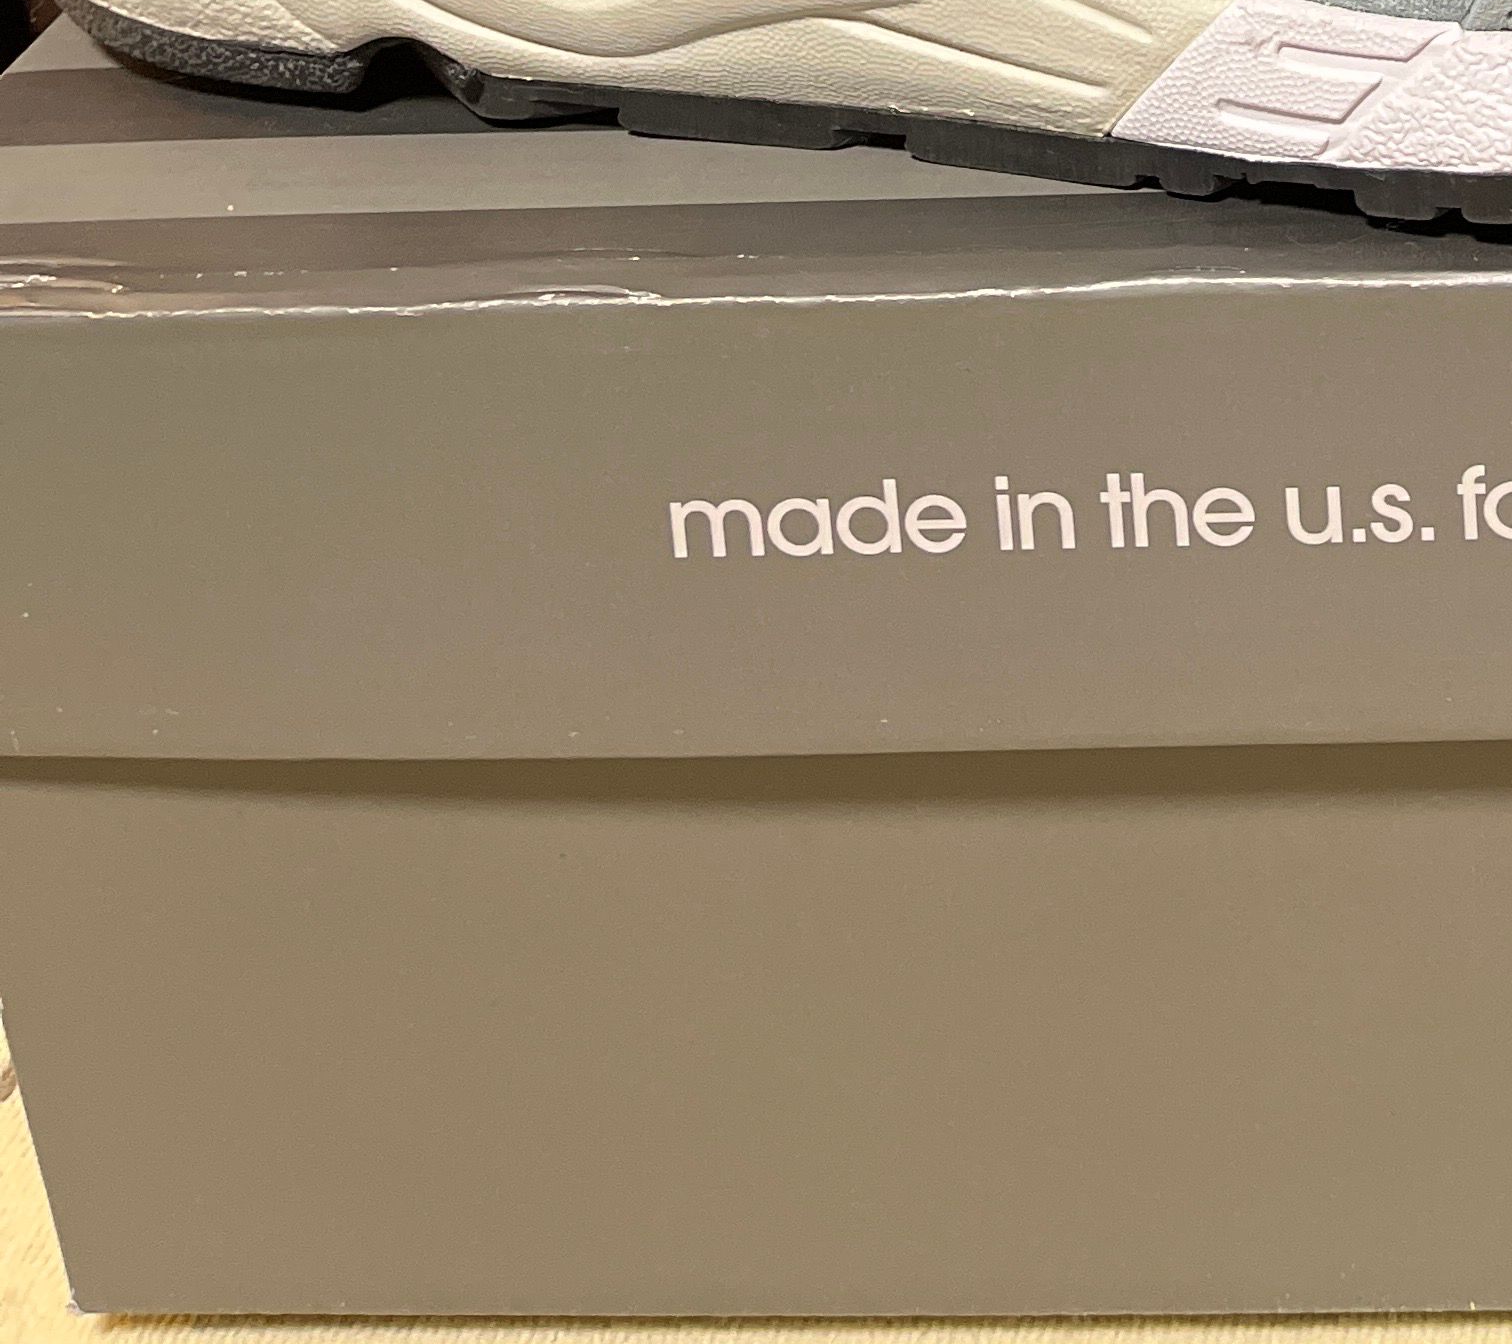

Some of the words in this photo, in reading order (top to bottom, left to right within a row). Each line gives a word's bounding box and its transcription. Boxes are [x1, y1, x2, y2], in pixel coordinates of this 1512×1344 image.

[669, 478, 967, 559] made
[994, 475, 1076, 551] in
[1099, 472, 1256, 548] the
[1285, 483, 1435, 545] u.s.
